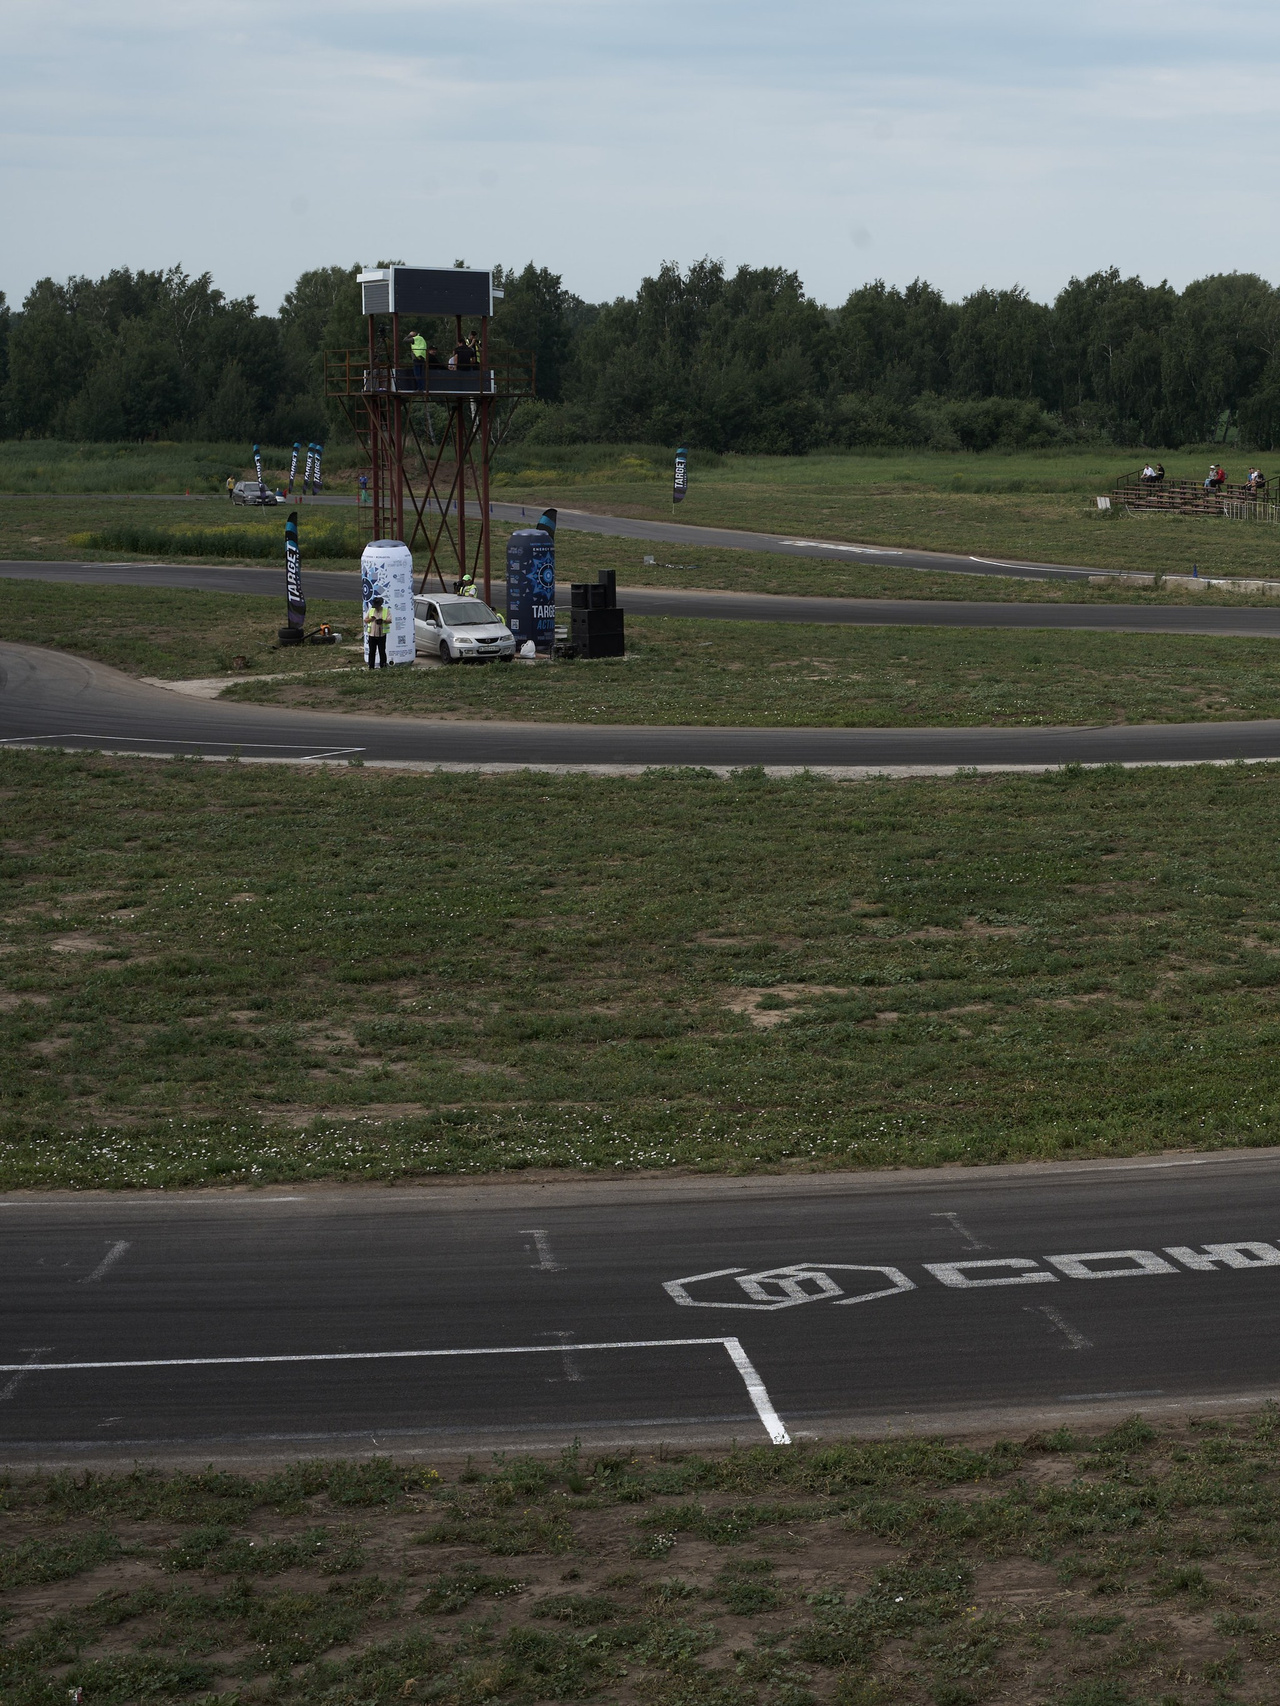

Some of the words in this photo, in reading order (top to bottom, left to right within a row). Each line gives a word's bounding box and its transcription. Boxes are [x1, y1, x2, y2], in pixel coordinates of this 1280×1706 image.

[674, 457, 685, 489] TARGET
[286, 541, 300, 602] TARGET
[531, 605, 555, 618] TARGE
